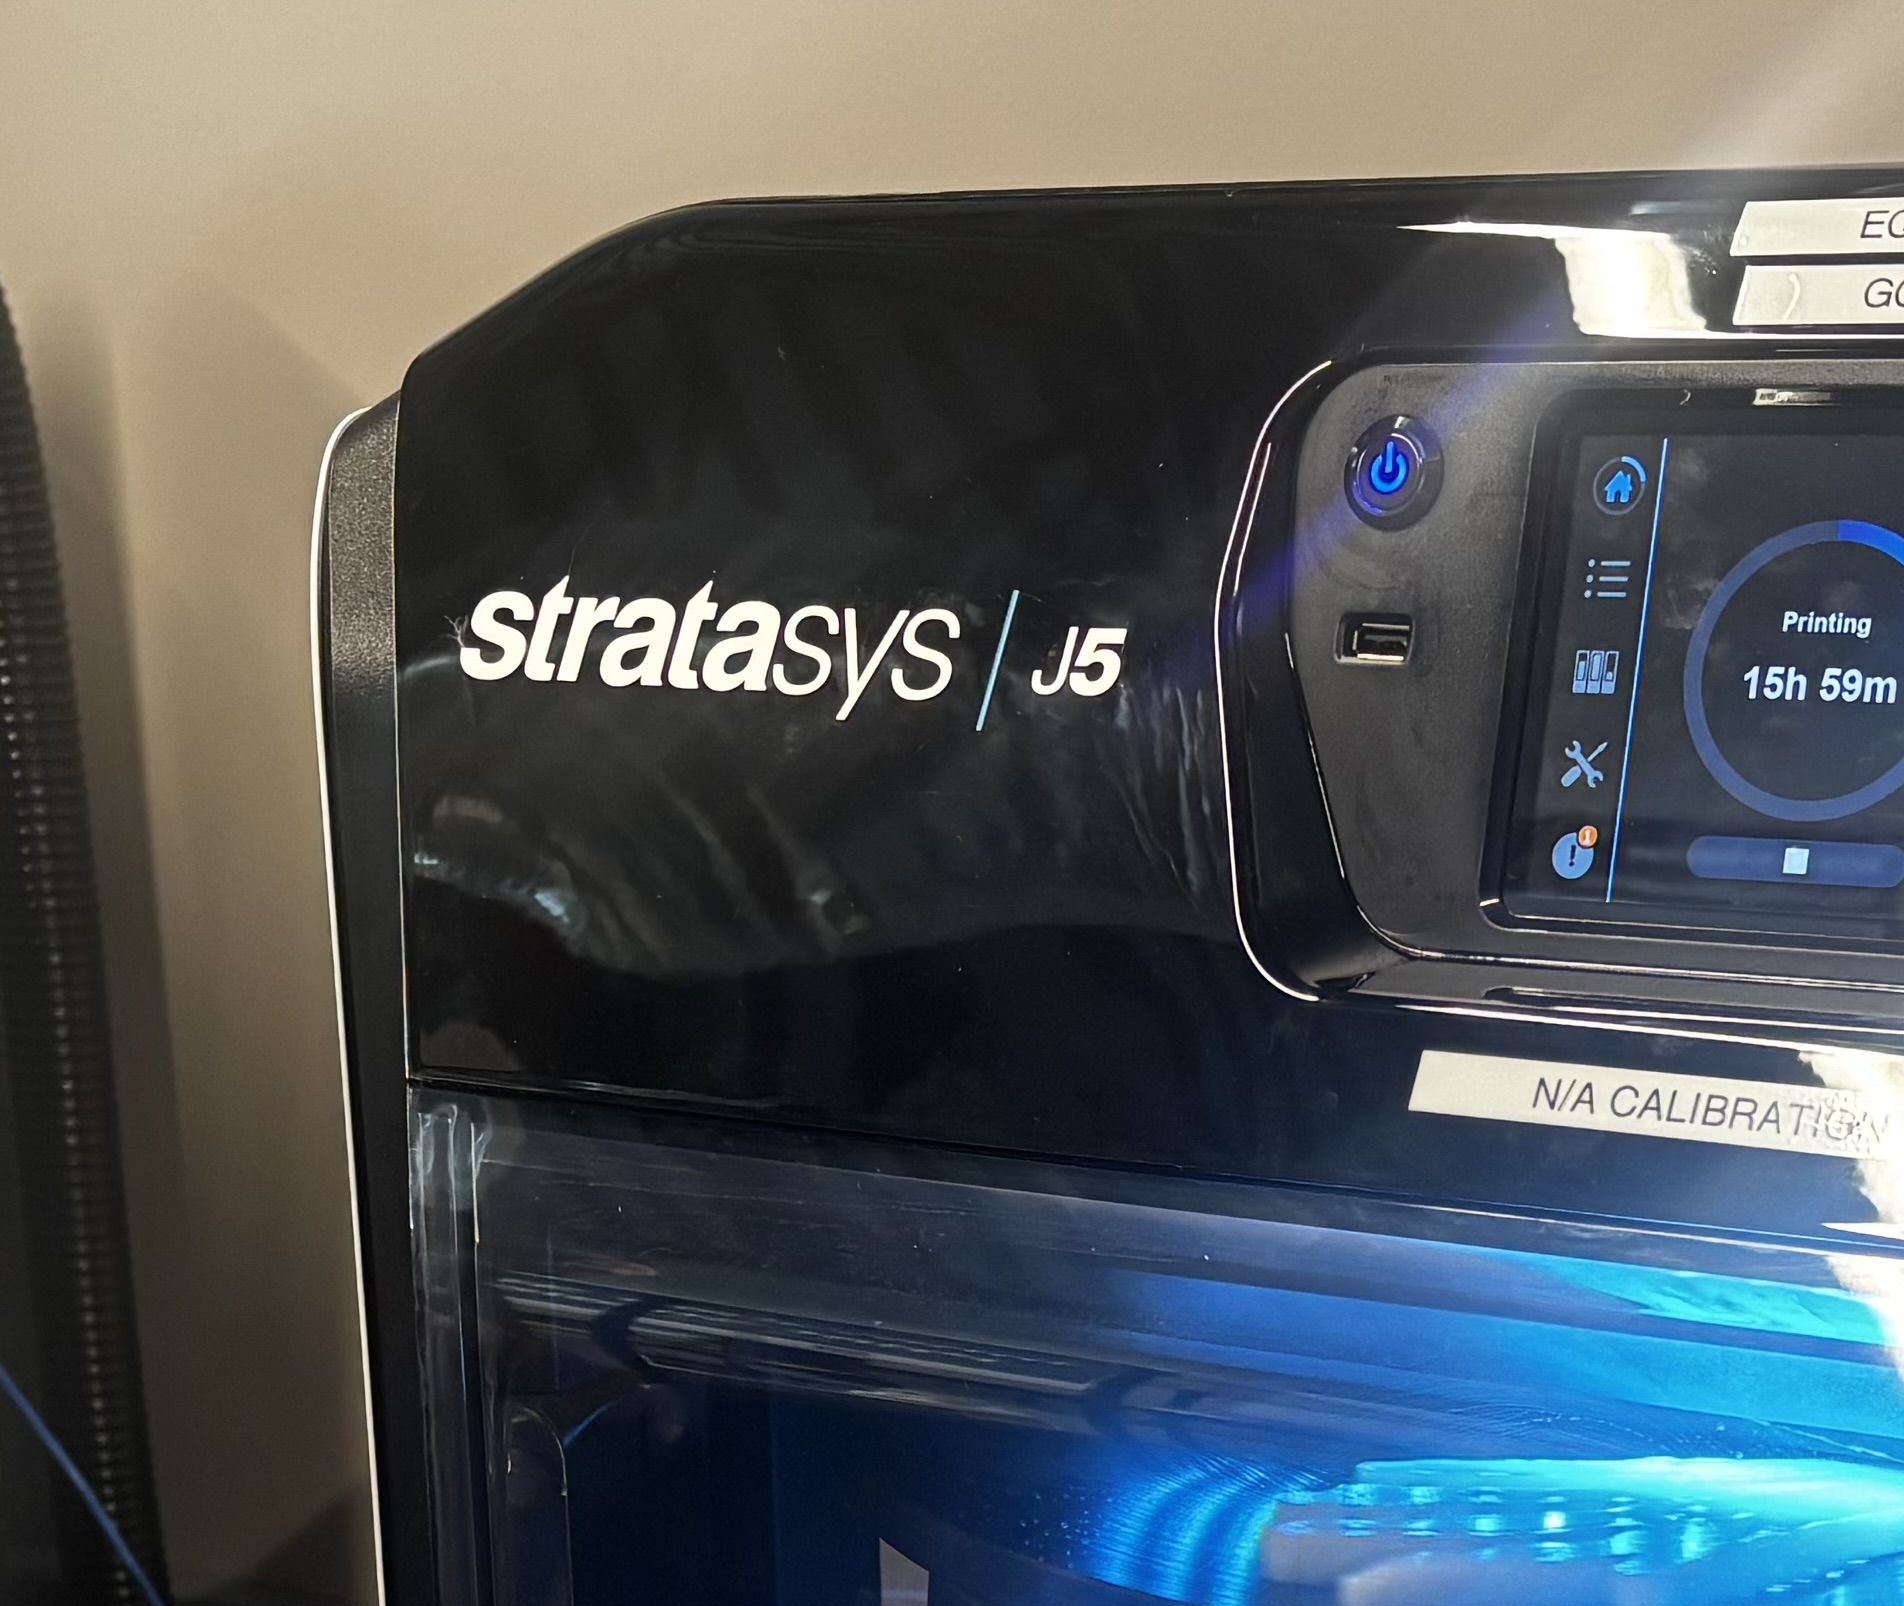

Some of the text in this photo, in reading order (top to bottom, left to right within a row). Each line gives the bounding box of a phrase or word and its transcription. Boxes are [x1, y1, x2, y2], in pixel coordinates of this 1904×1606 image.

[1781, 610, 1873, 639] Printing
[459, 575, 1128, 722] stratasys J5
[1743, 665, 1897, 704] 15h 59m
[1531, 1076, 1595, 1115] N/A
